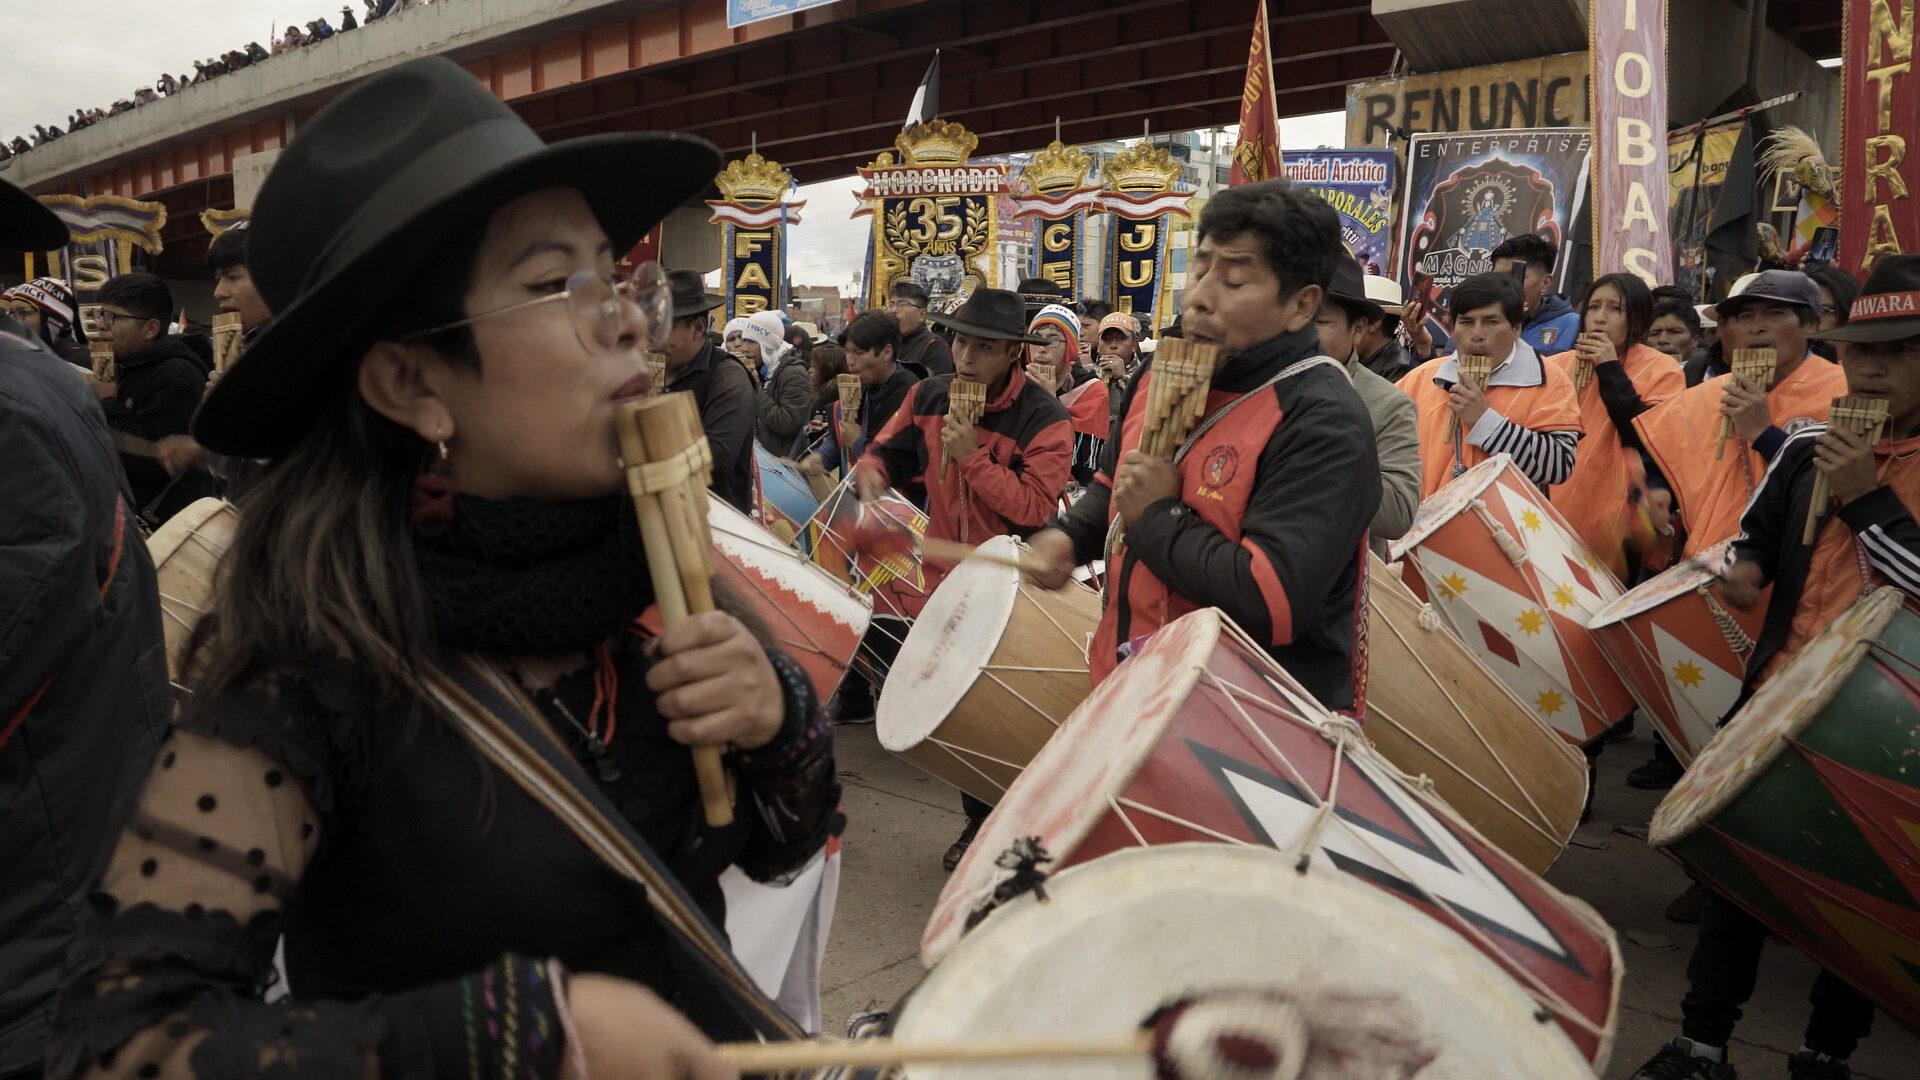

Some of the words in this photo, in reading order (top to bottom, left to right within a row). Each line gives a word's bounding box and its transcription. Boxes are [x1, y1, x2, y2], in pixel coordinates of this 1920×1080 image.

[1420, 138, 1591, 158] ENTERPRISE
[873, 168, 999, 196] MORENADA
[909, 196, 963, 243] 35
[1310, 188, 1388, 234] APORALES
[735, 232, 772, 318] FAB
